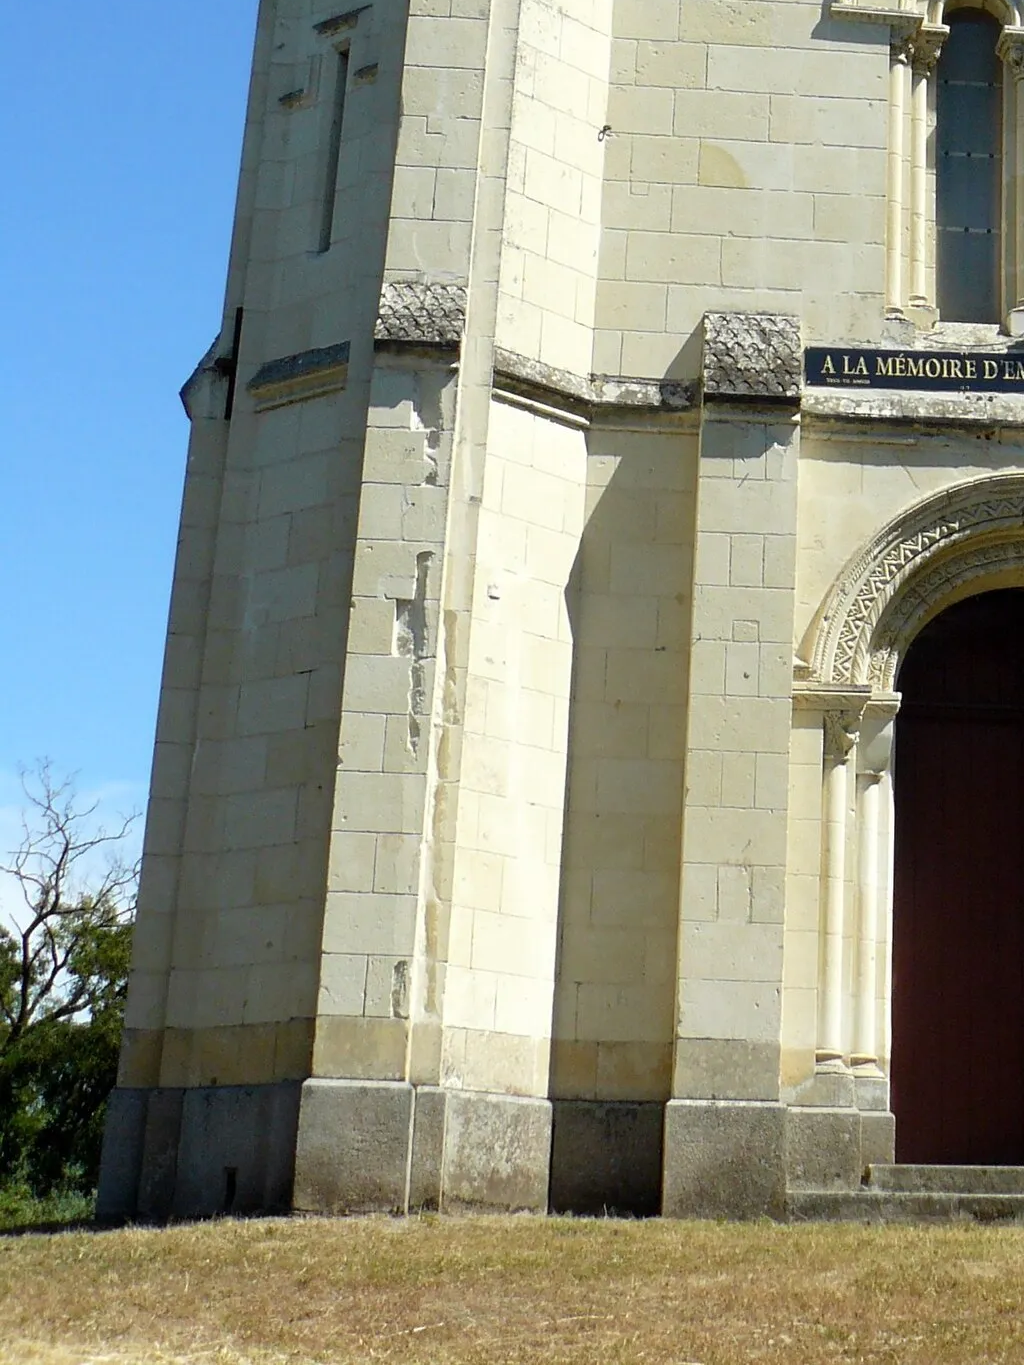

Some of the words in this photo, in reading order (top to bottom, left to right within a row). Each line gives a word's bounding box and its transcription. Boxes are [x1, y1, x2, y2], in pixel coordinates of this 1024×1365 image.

[820, 355, 836, 374] A
[843, 355, 869, 375] LA
[875, 353, 977, 379] MÉMOIRE
